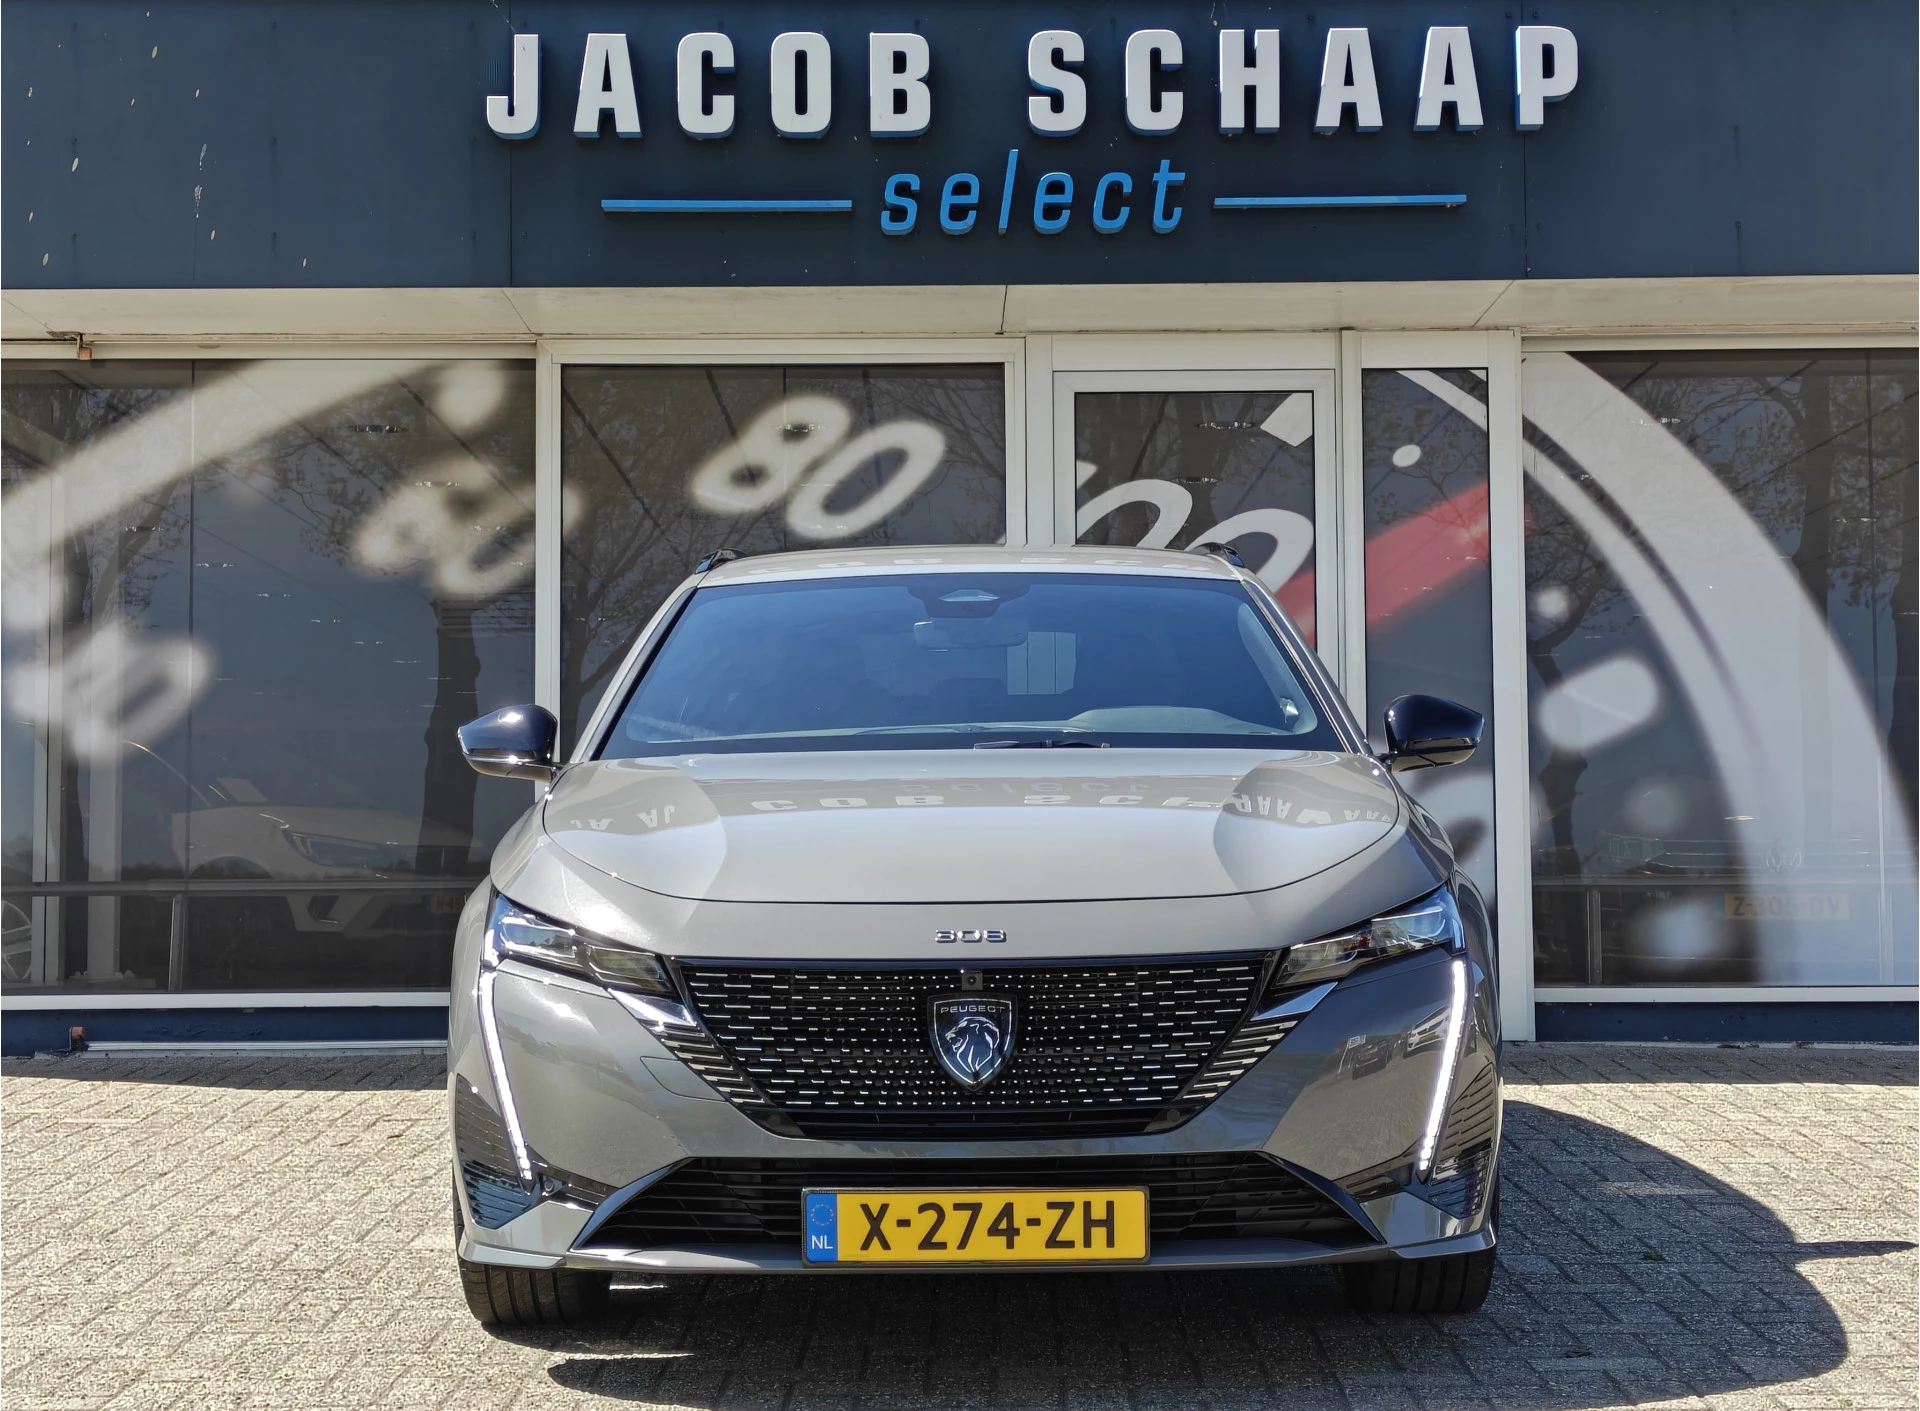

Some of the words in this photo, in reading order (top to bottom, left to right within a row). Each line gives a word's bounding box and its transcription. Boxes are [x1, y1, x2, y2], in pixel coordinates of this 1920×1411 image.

[487, 32, 932, 139] JACOB
[1028, 26, 1579, 136] SCHAAP
[881, 149, 1186, 234] select
[692, 394, 946, 540] 80
[935, 929, 1006, 943] 308
[940, 1004, 1006, 1013] PEUGEOT
[811, 1235, 834, 1250] NL
[859, 1200, 1116, 1251] X-274-ZH
